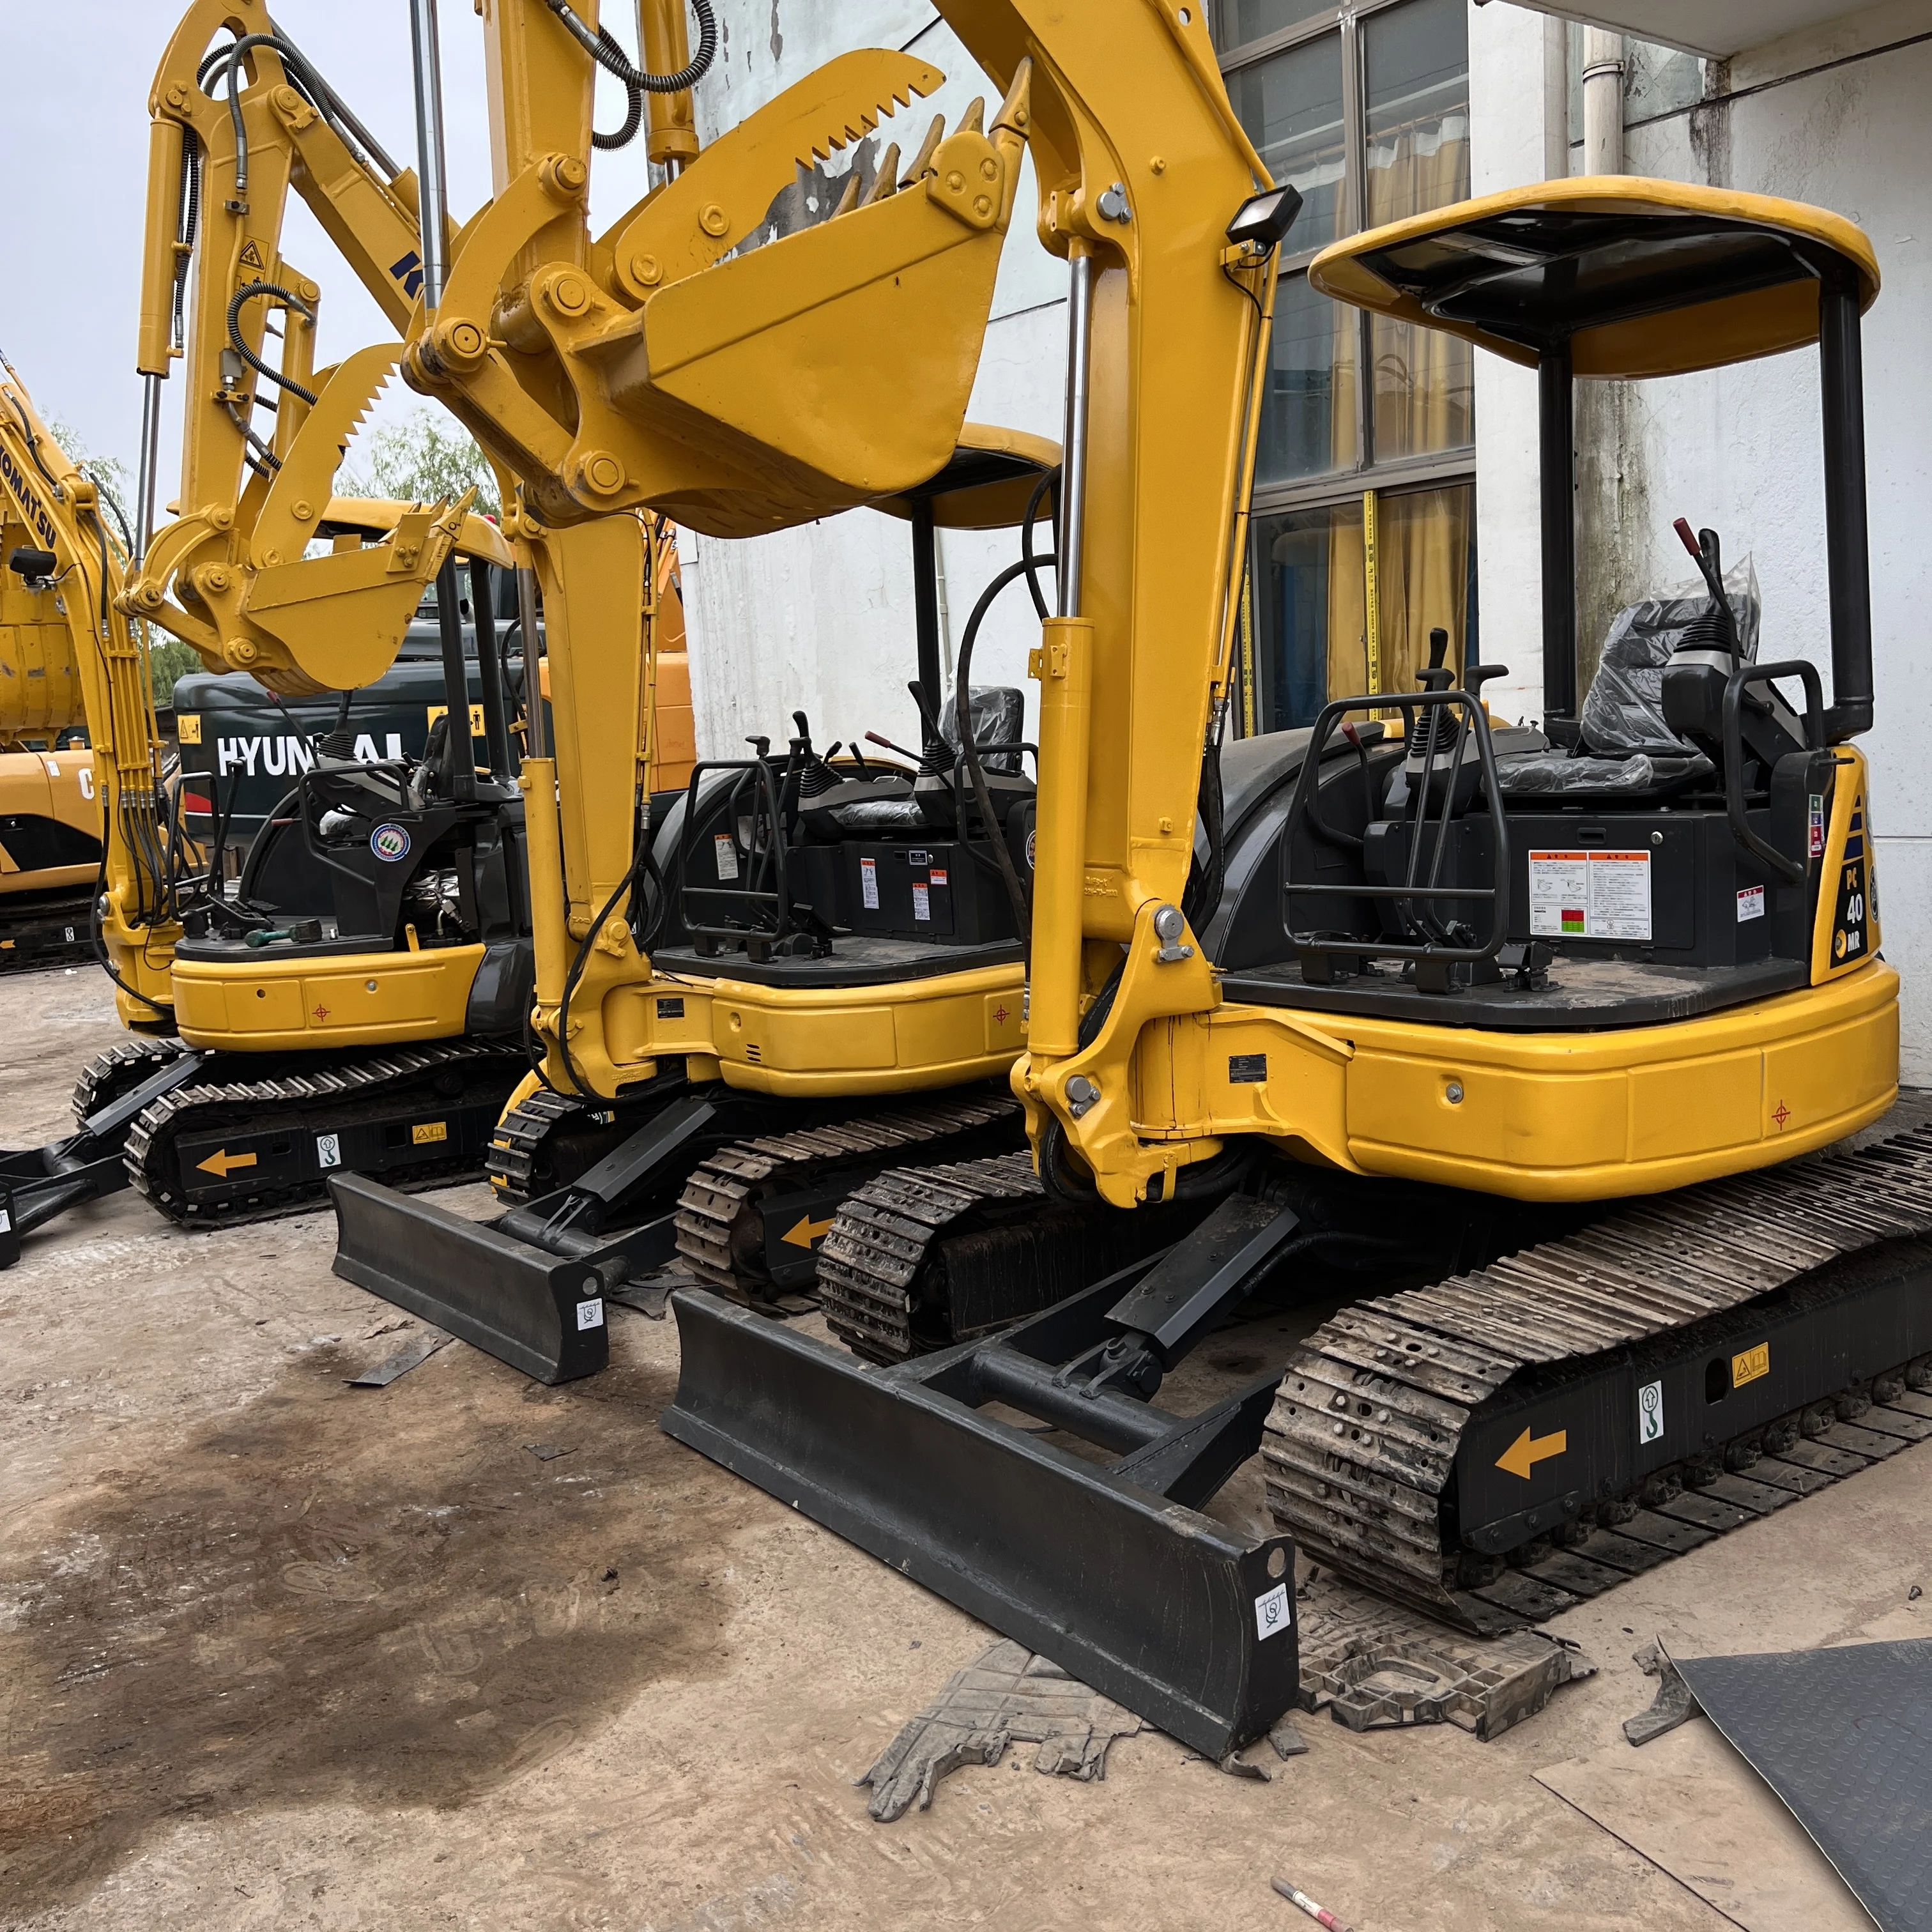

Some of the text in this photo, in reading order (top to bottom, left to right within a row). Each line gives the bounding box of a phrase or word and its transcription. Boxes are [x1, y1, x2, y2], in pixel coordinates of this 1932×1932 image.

[0, 444, 56, 549] OMATSU
[217, 733, 402, 776] HYUNAI
[1846, 866, 1857, 890] PC
[1846, 893, 1863, 924] 40
[1847, 930, 1860, 952] MR
